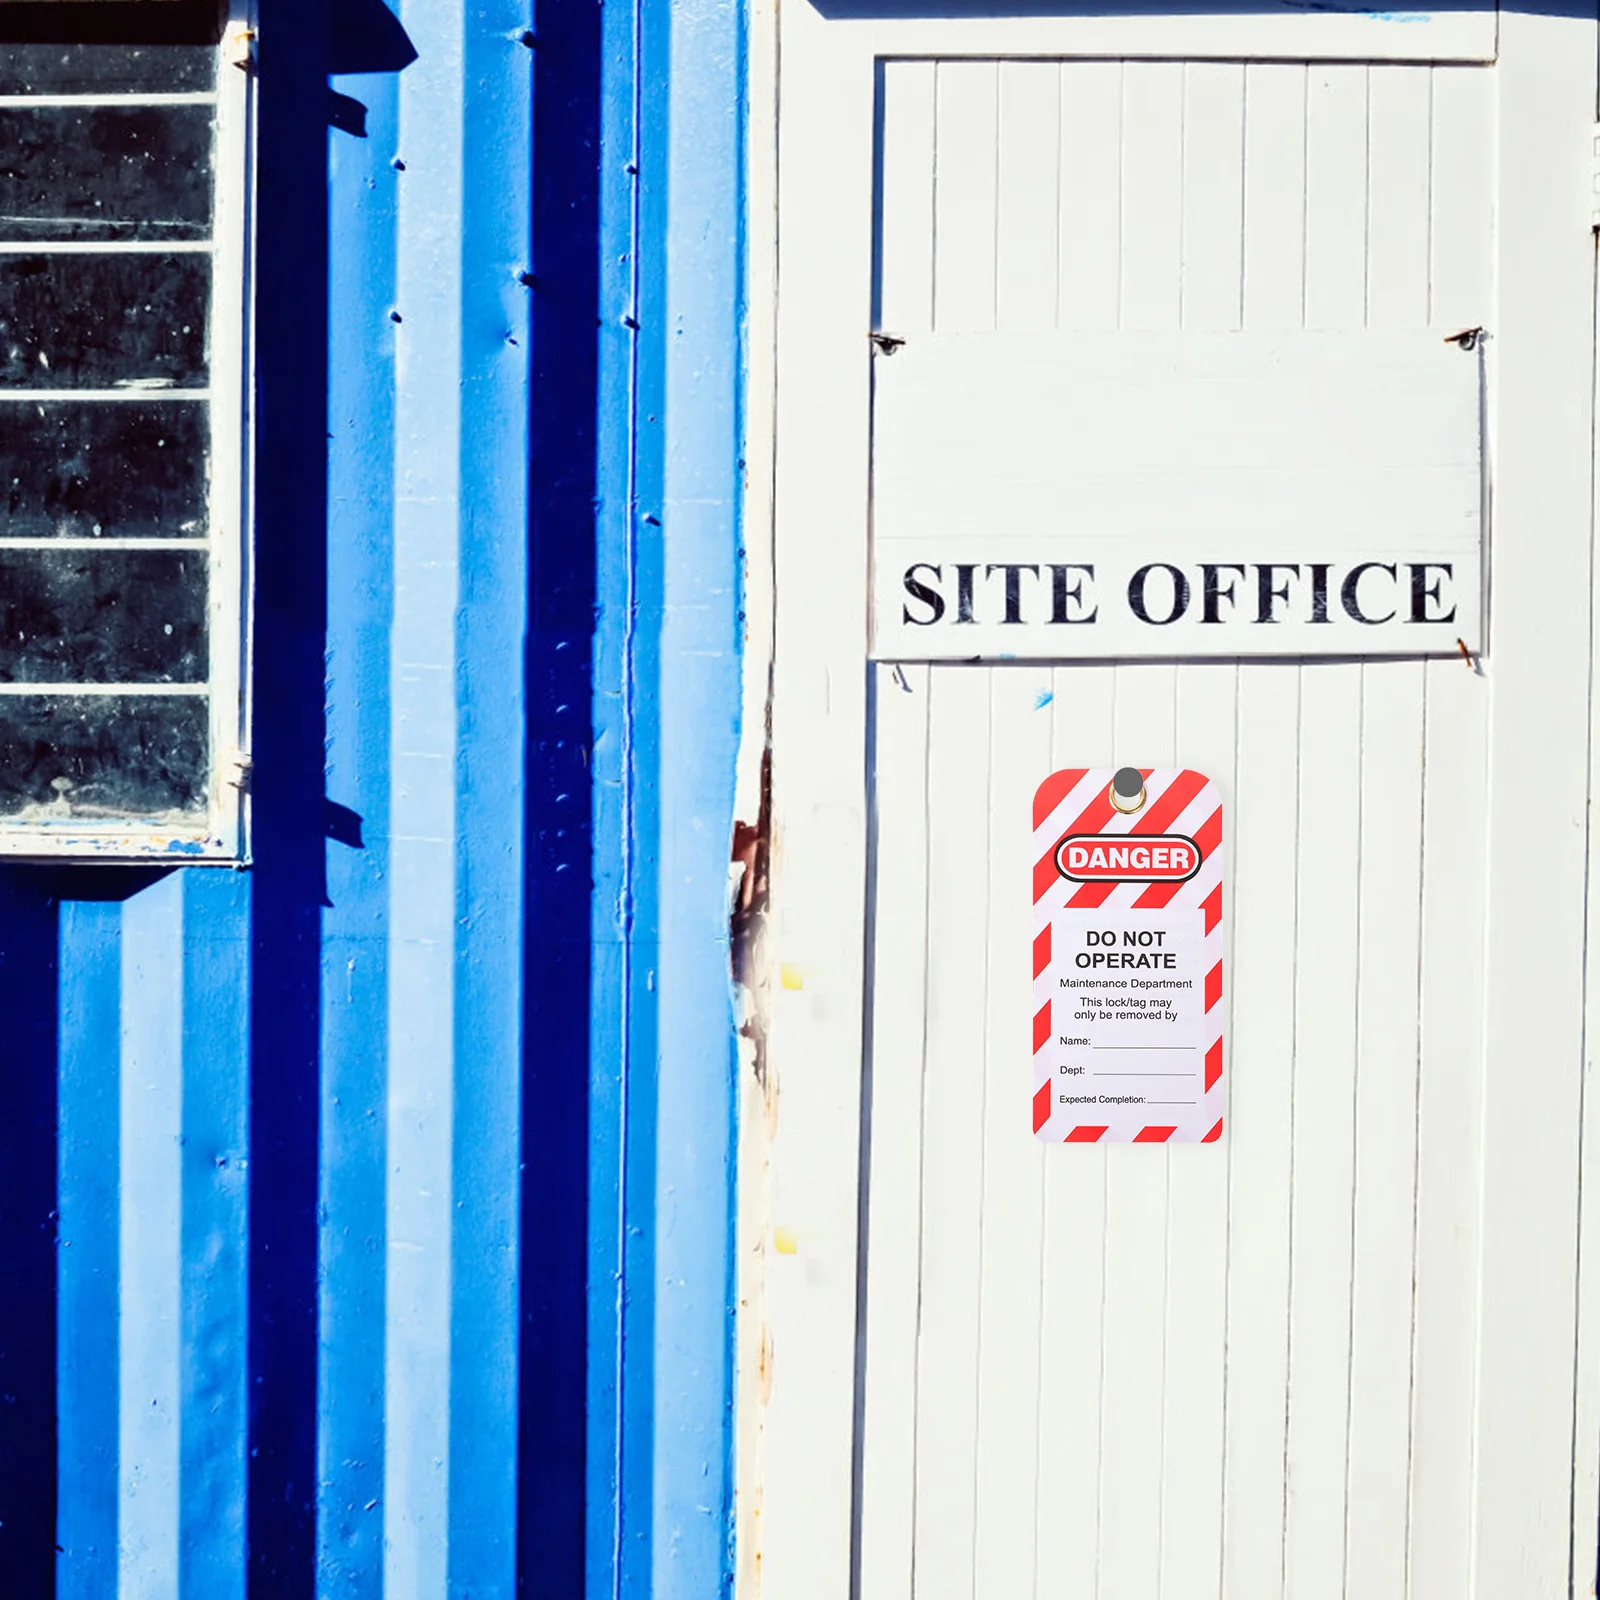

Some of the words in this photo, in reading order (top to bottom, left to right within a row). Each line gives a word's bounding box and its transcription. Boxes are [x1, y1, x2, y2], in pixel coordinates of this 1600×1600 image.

[903, 563, 1098, 625] SITE
[1128, 562, 1456, 625] OFFICE
[1070, 848, 1188, 868] DANGER
[1087, 931, 1116, 946] DO
[1124, 931, 1166, 946] NOT
[1076, 953, 1176, 969] OPERATE
[1060, 979, 1127, 988] Maintenance
[1131, 979, 1192, 990] Department
[1080, 997, 1102, 1007] This
[1106, 998, 1146, 1009] lock/tag
[1150, 1000, 1172, 1009] may
[1074, 1010, 1096, 1021] only
[1100, 1010, 1112, 1019] be
[1116, 1011, 1161, 1019] removed
[1165, 1011, 1177, 1022] by
[1060, 1037, 1091, 1045] Name:
[1060, 1066, 1085, 1076] Dept:
[1060, 1095, 1096, 1104] Expected
[1099, 1095, 1146, 1105] Completion:
